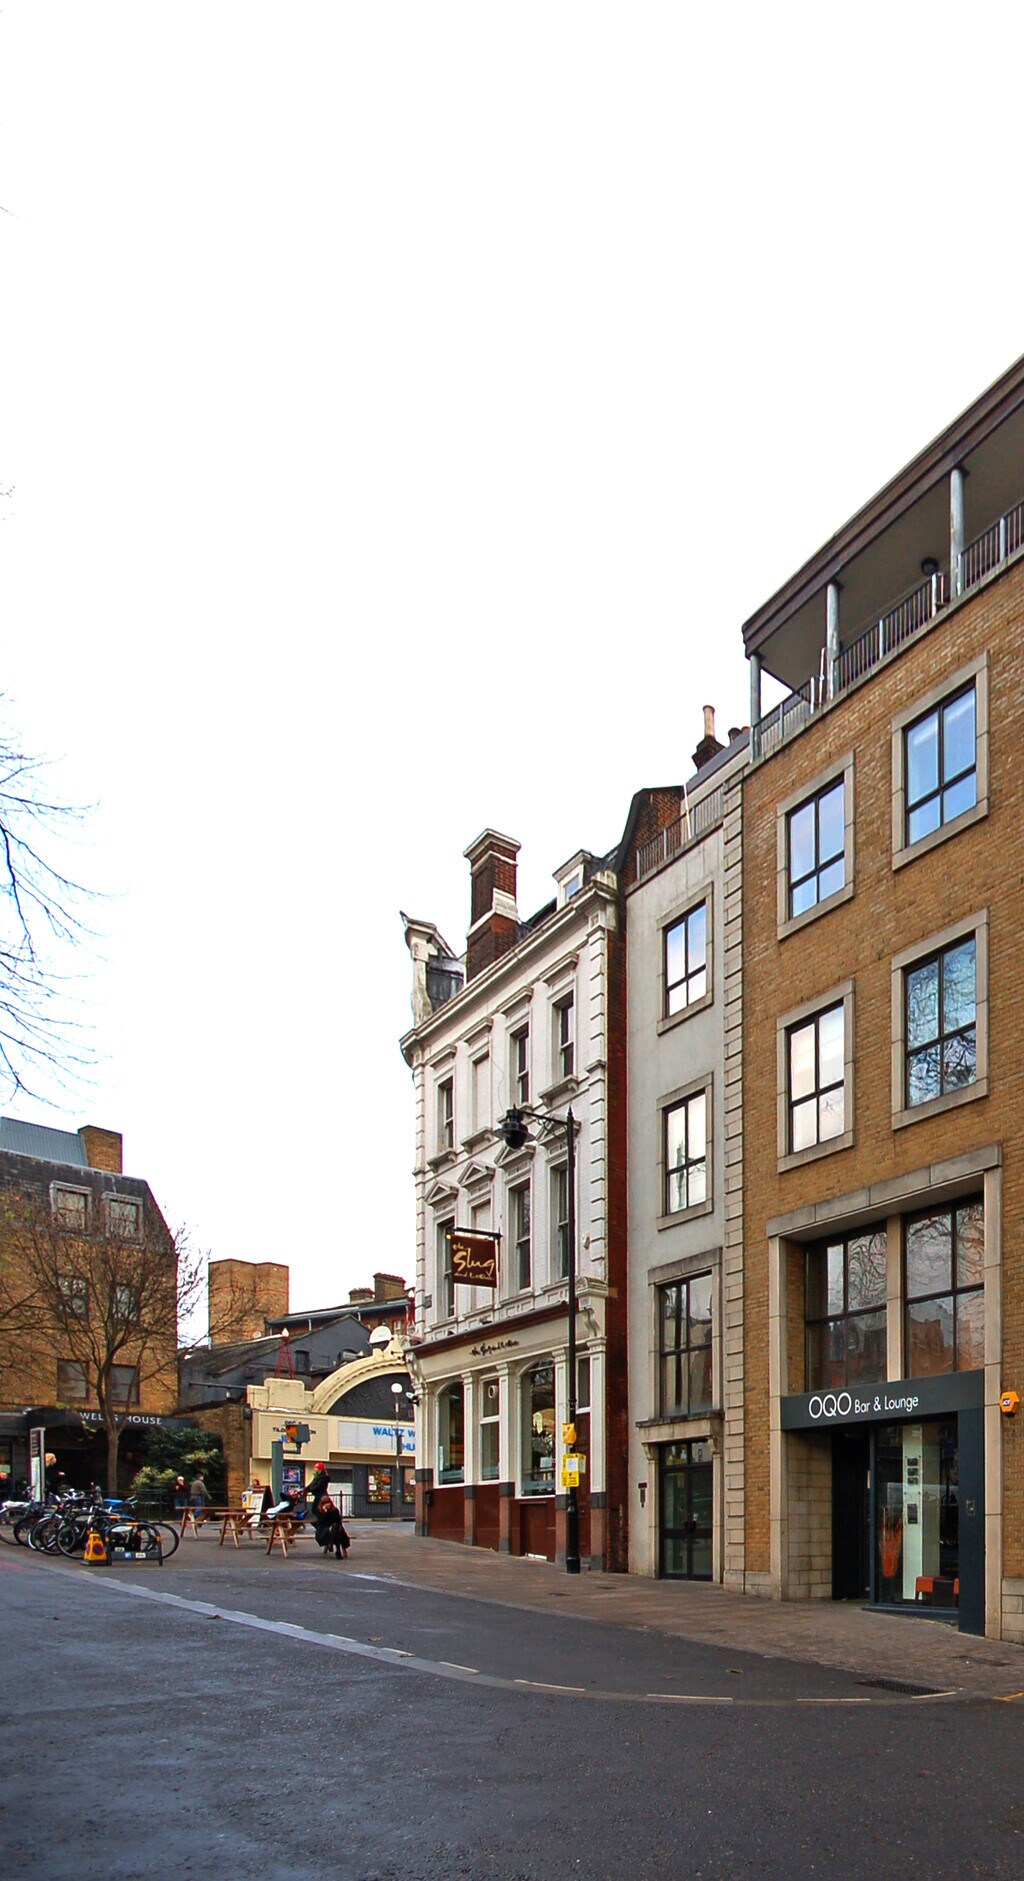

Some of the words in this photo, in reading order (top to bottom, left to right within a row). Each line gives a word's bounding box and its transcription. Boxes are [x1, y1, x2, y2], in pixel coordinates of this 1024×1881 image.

[453, 1248, 495, 1276] Slug
[808, 1392, 852, 1419] OQO
[854, 1399, 871, 1414] Bar
[873, 1396, 882, 1412] &
[884, 1395, 919, 1412] Lounge
[80, 1412, 119, 1422] WELS
[372, 1427, 404, 1437] WALTZ
